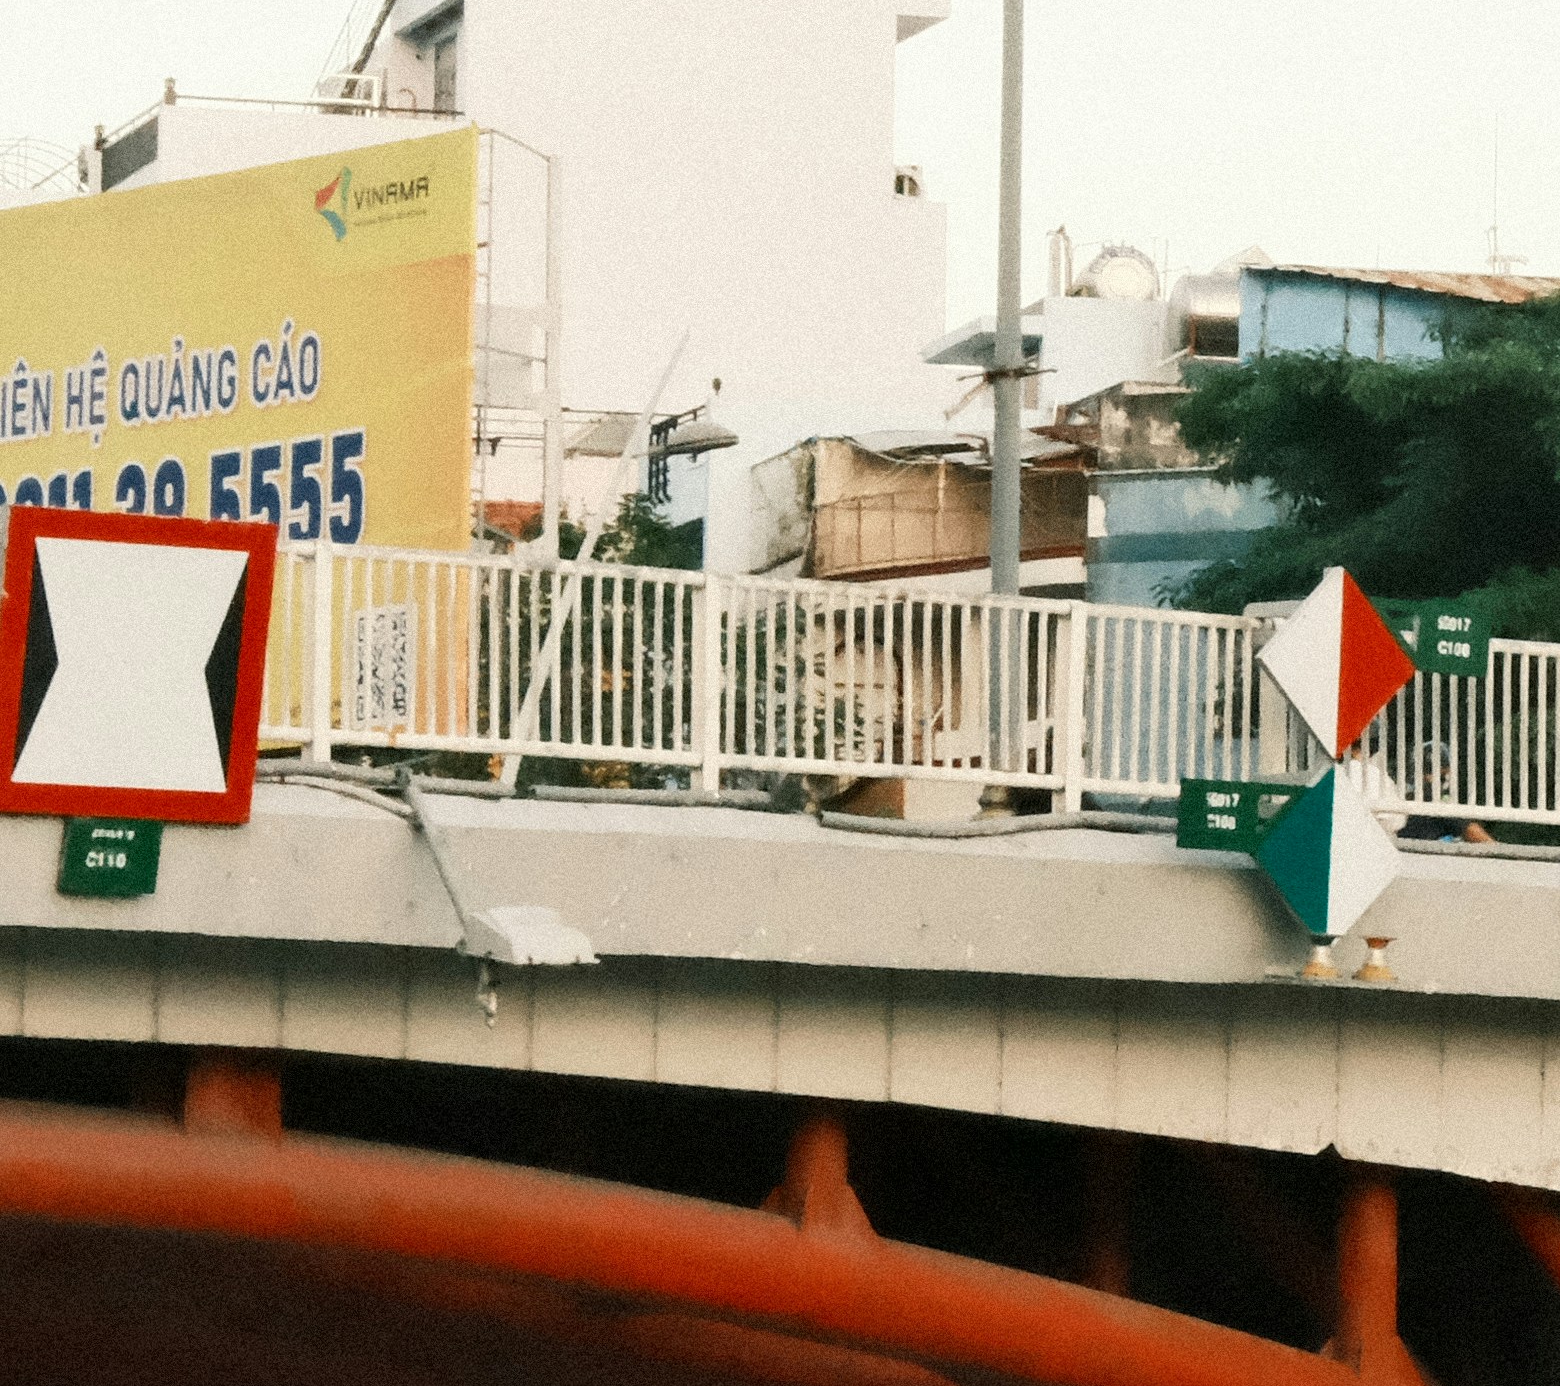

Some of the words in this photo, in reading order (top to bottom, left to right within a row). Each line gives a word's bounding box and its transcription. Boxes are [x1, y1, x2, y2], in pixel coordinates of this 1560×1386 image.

[354, 176, 429, 209] VINAMA
[66, 350, 105, 444] HỆ
[121, 339, 237, 421] QUẢNG
[252, 320, 320, 403] CÁO
